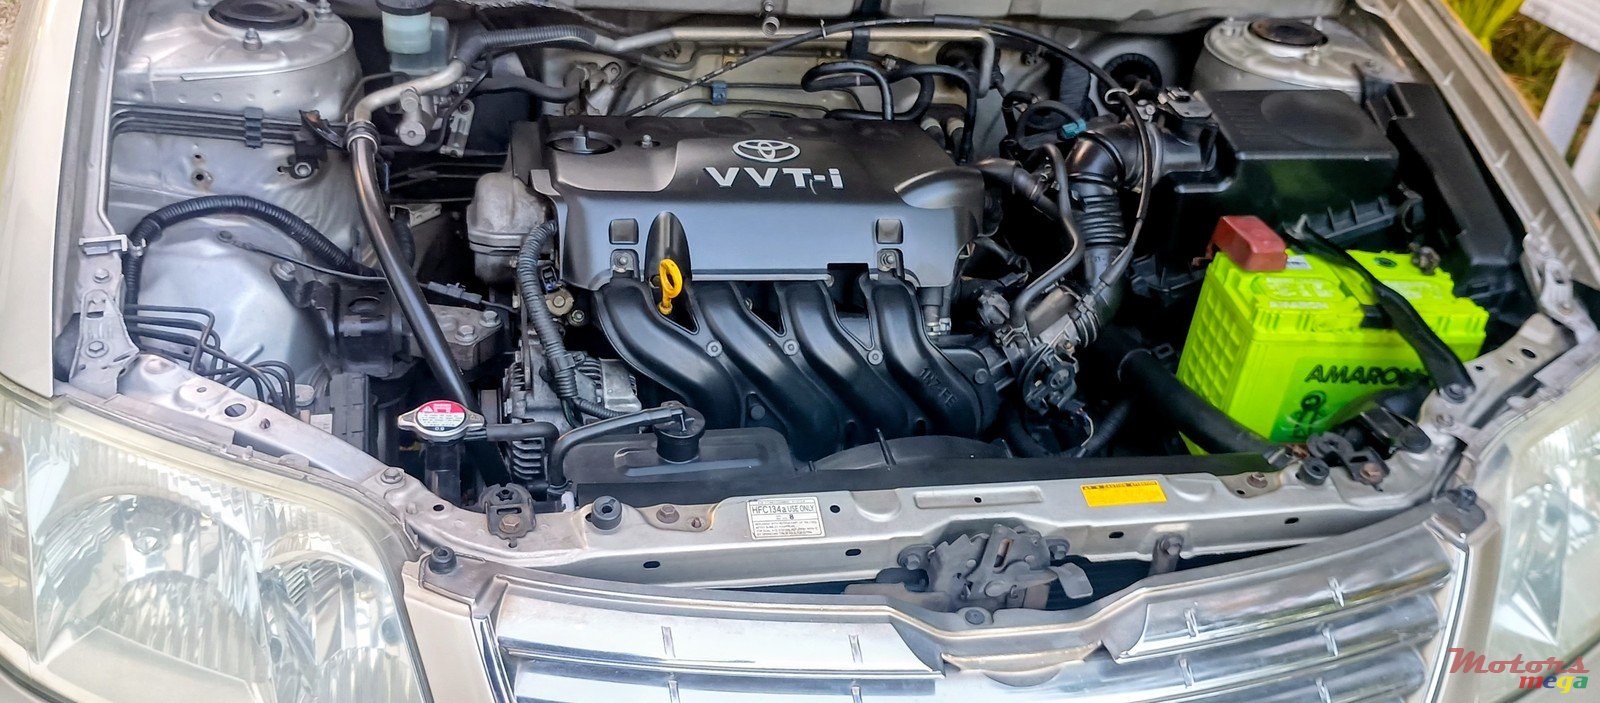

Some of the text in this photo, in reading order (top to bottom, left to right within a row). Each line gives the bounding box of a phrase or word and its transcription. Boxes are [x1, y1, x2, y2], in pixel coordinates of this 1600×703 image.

[704, 167, 844, 189] VVT-i
[787, 505, 799, 513] USE
[800, 504, 815, 512] ONLY
